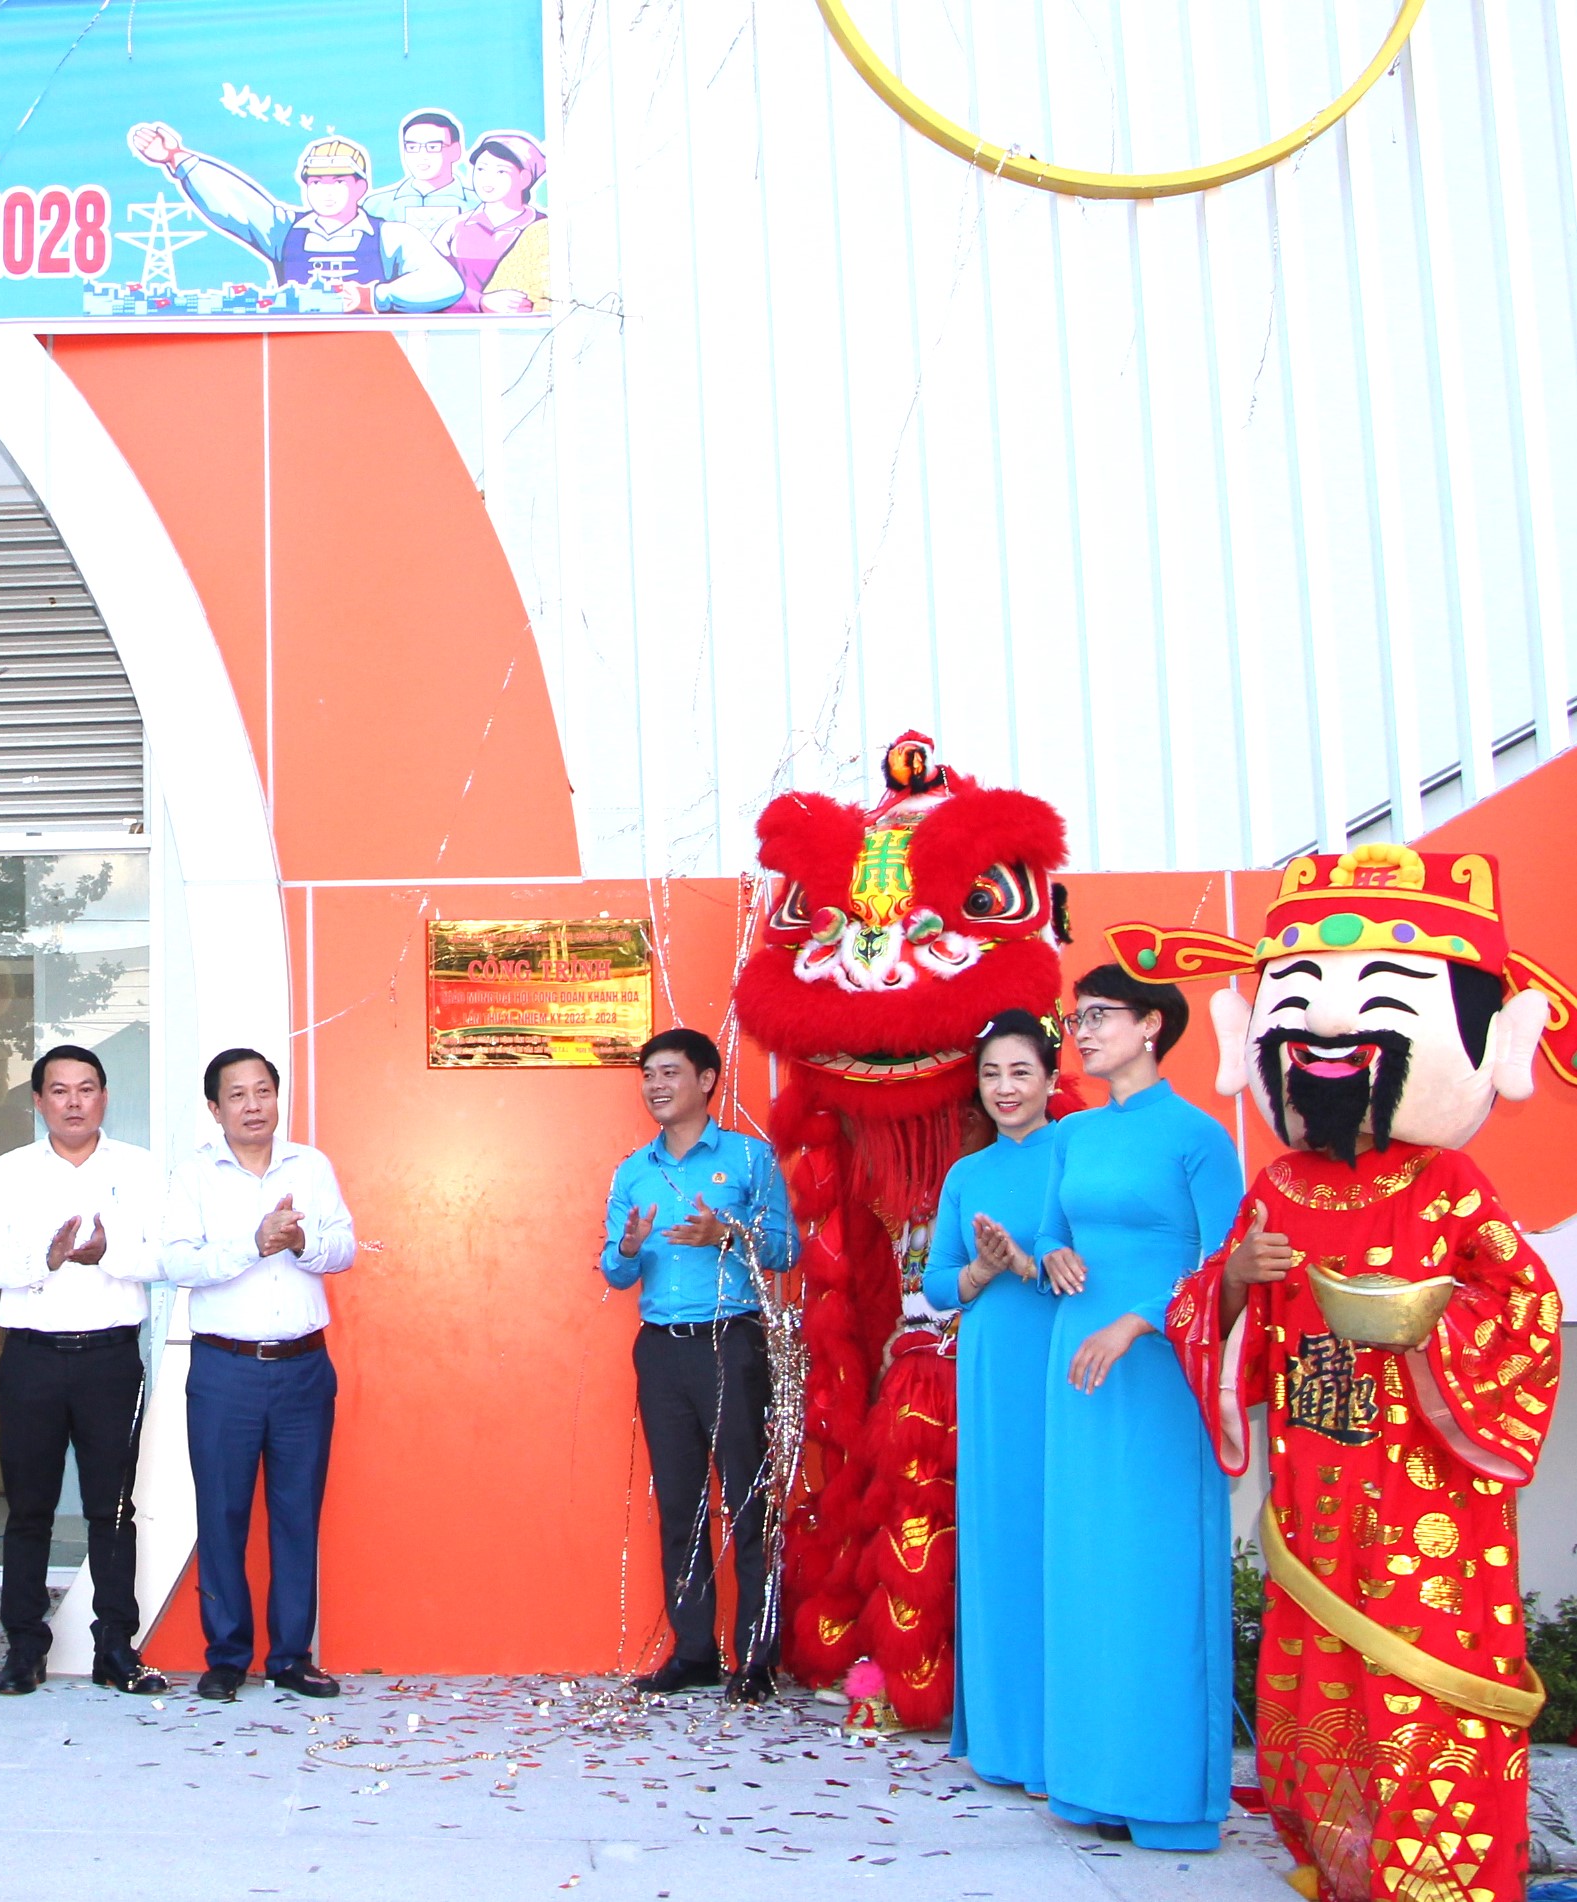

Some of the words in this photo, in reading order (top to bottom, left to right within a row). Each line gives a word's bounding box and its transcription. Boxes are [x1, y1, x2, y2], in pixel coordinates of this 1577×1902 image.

[467, 954, 533, 982] CÔNG
[538, 953, 612, 982] TRÌNH
[564, 1012, 586, 1024] 2023
[595, 1012, 617, 1024] 2028
